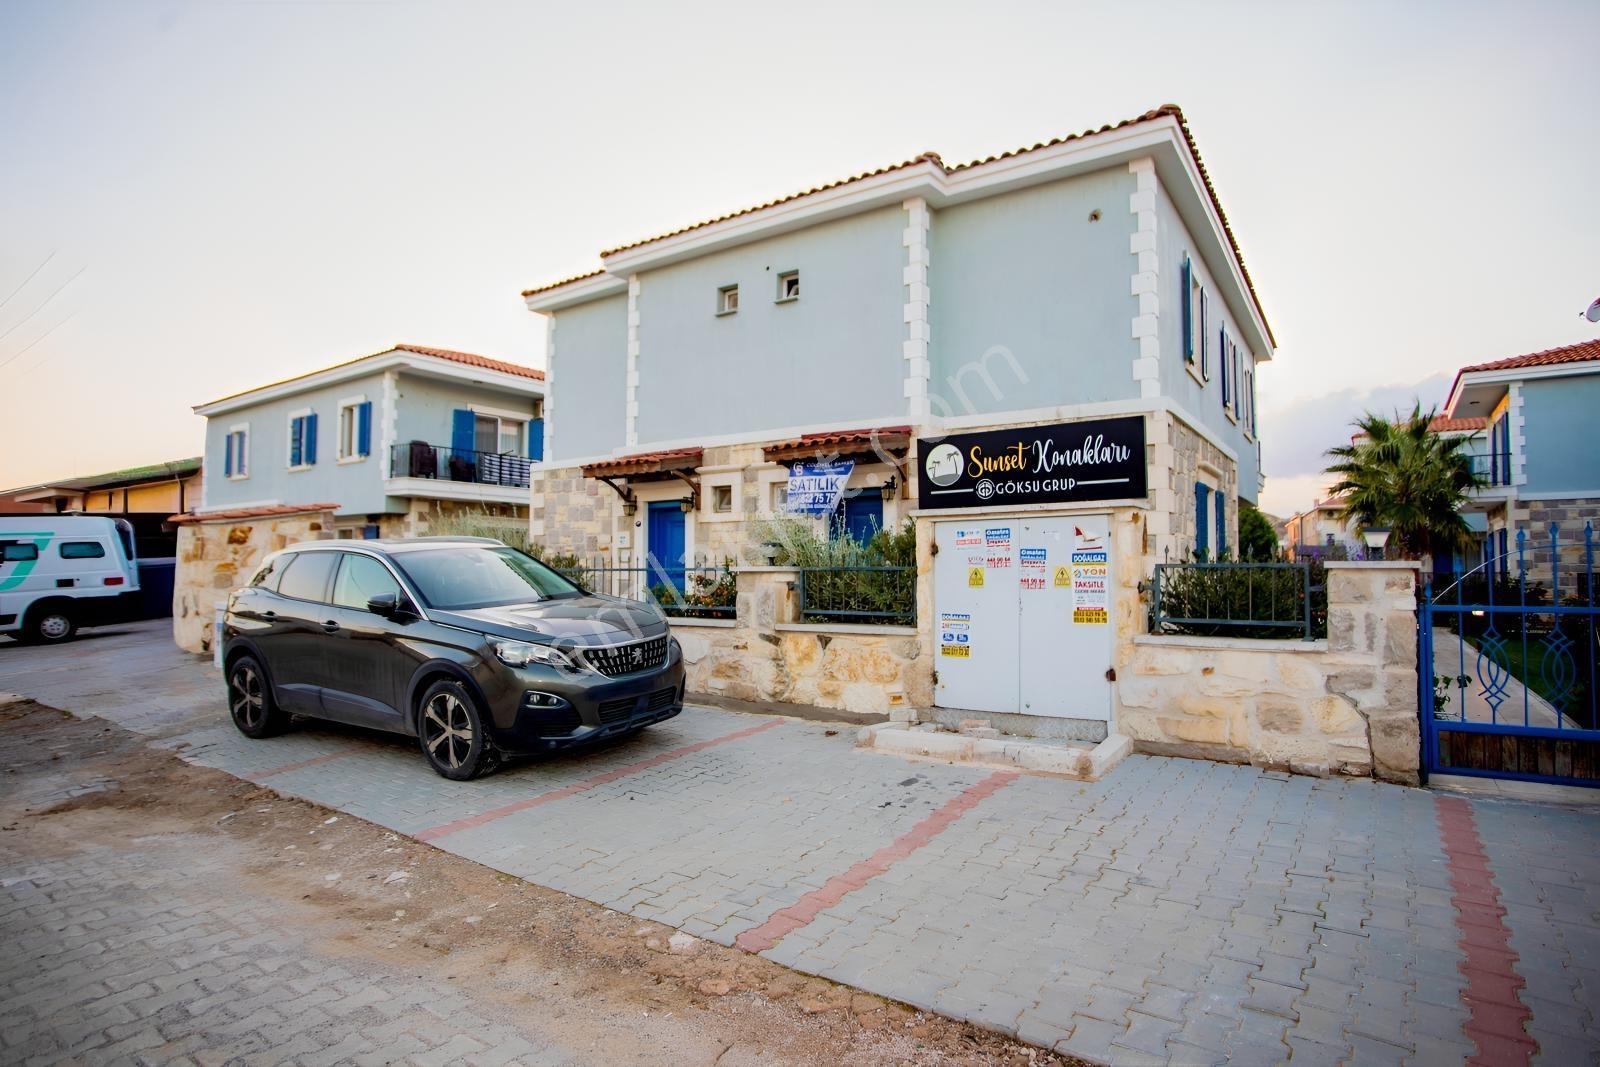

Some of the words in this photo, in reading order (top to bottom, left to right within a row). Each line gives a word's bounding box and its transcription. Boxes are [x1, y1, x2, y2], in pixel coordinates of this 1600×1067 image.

[968, 442, 1031, 477] Sunset
[1032, 434, 1130, 474] Konakları
[790, 477, 839, 491] SATILIK
[996, 480, 1039, 494] GÖKSU
[1042, 478, 1075, 492] GRUP
